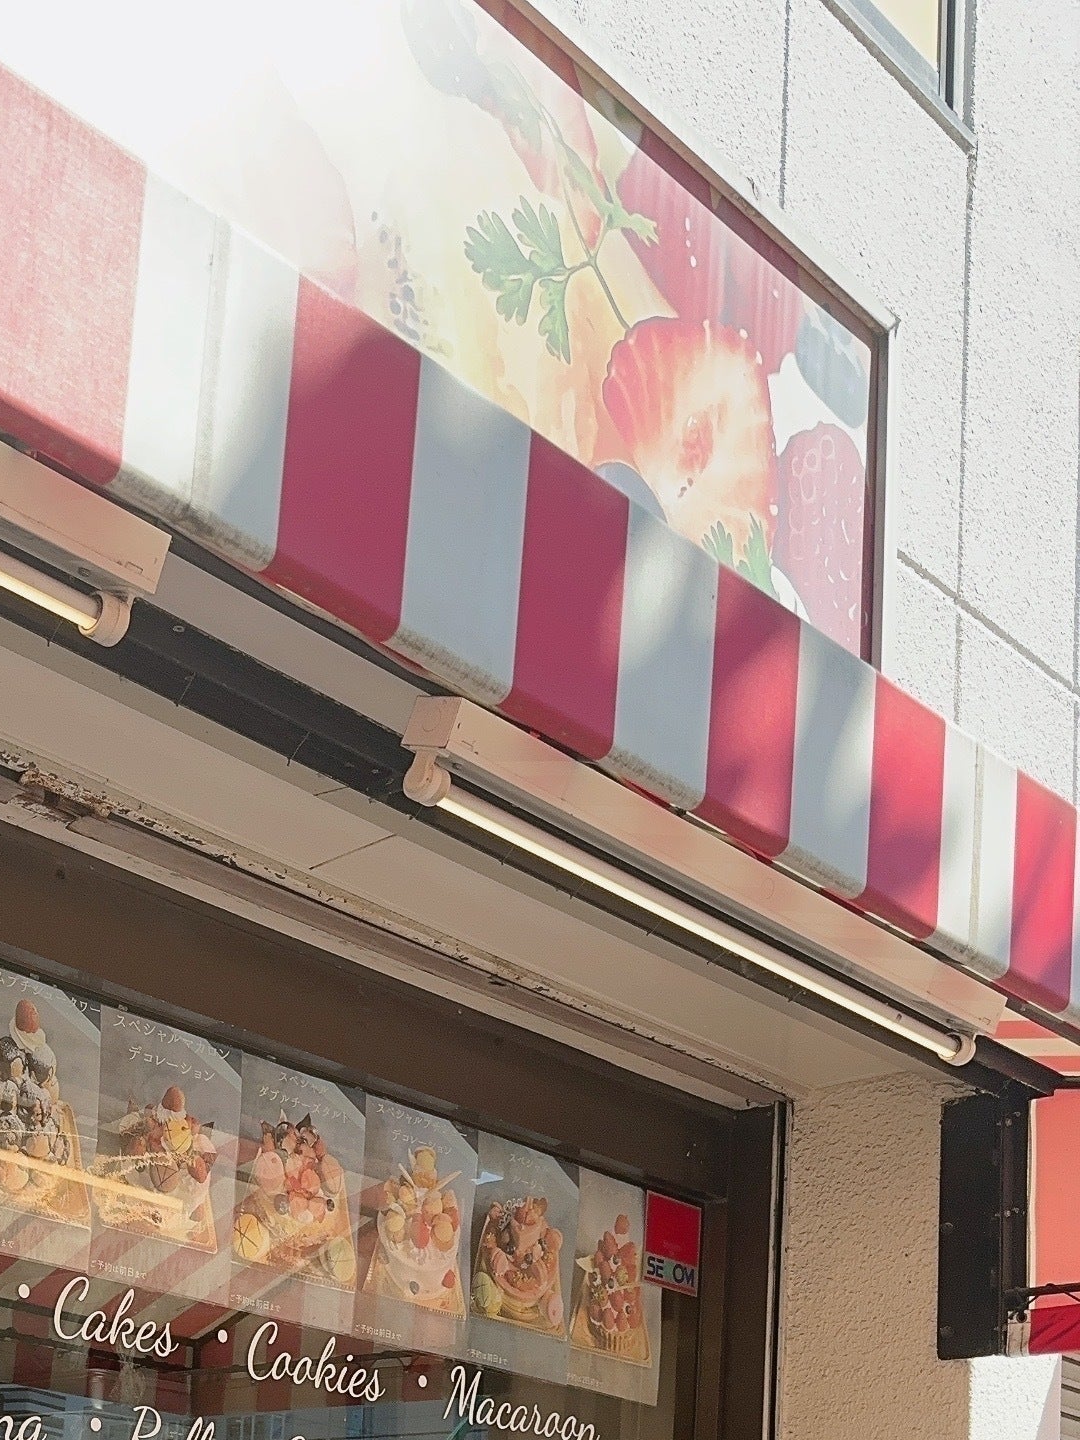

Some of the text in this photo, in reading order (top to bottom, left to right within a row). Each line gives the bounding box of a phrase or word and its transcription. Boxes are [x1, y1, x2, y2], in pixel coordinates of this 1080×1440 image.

[113, 1014, 230, 1059] スペシャルマカロン
[128, 1046, 215, 1081] デコレーション
[90, 1259, 147, 1279] ご予約は前日まで
[646, 1256, 695, 1287] SEOM
[229, 1293, 282, 1311] ご予約は前日まで
[54, 1276, 180, 1358] Cakes
[247, 1321, 386, 1401] Cookies
[354, 1324, 402, 1341] ご予約は前日まで
